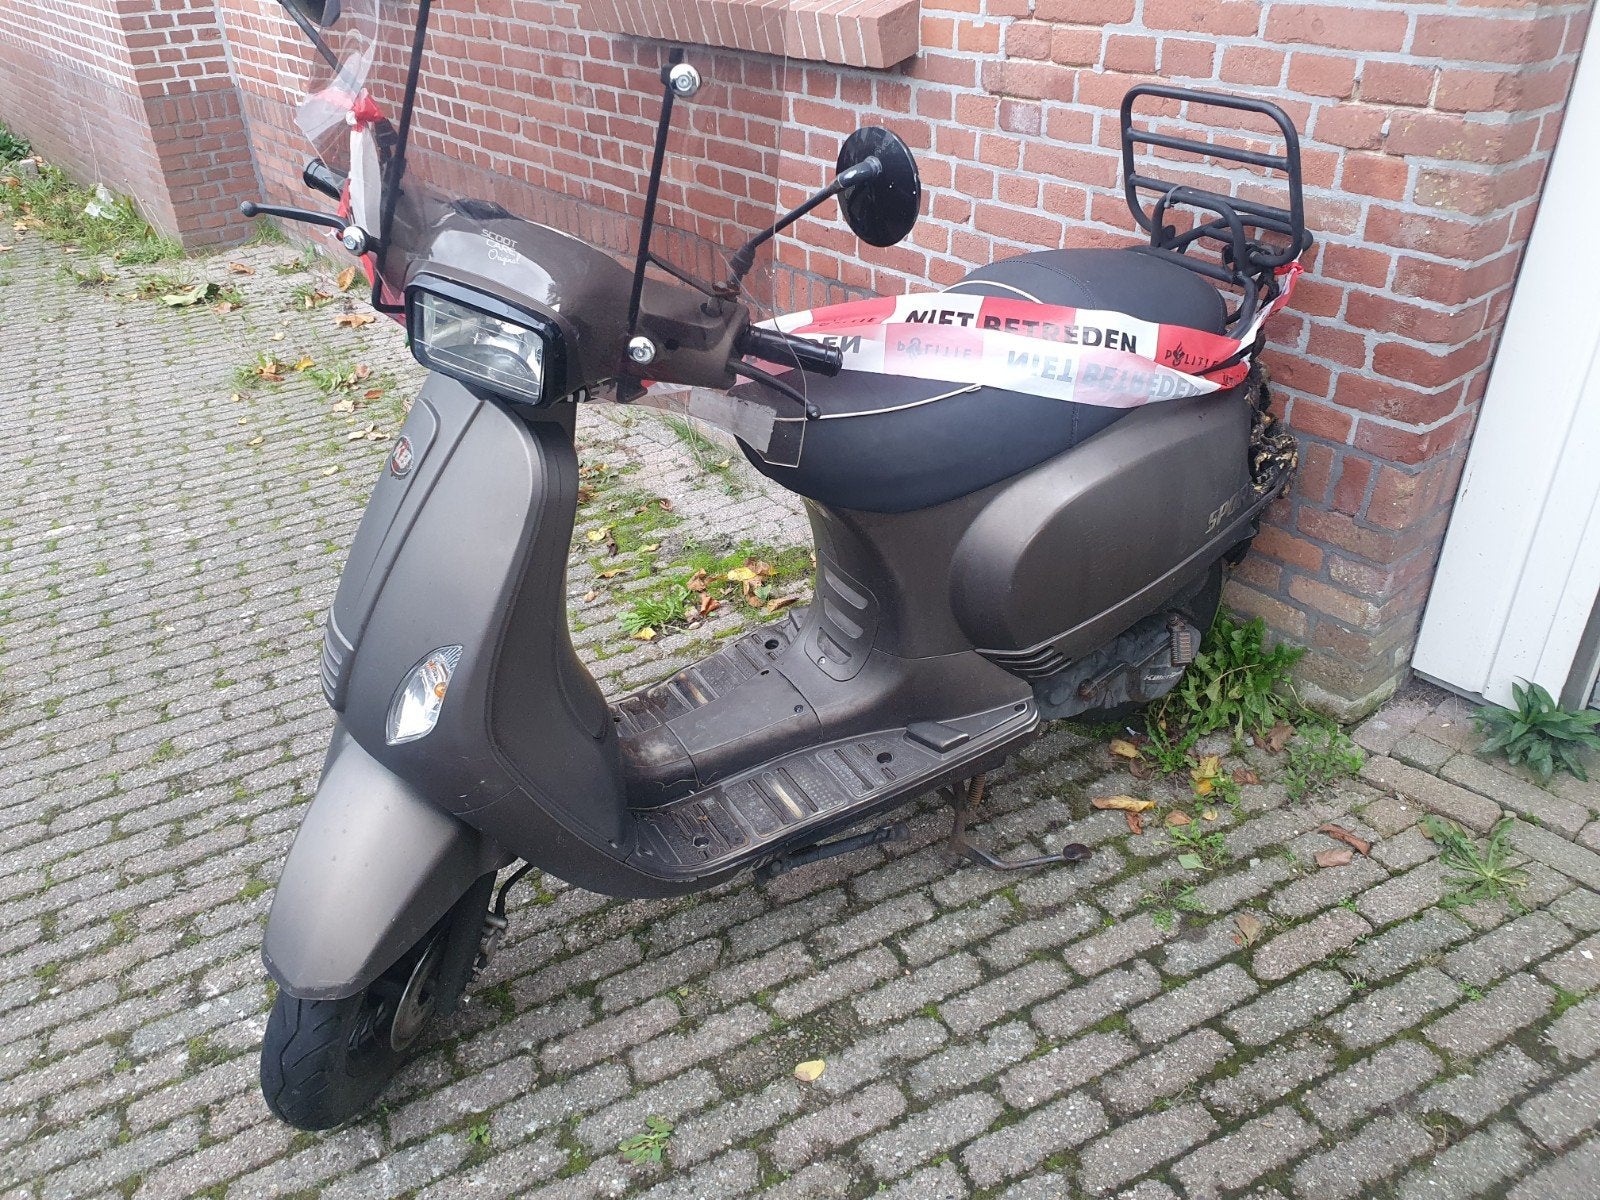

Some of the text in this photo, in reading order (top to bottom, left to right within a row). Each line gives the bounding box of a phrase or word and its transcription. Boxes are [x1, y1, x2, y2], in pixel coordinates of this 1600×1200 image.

[481, 228, 518, 247] SCOOT
[905, 309, 975, 328] NIET
[984, 315, 1137, 353] BETREDEN
